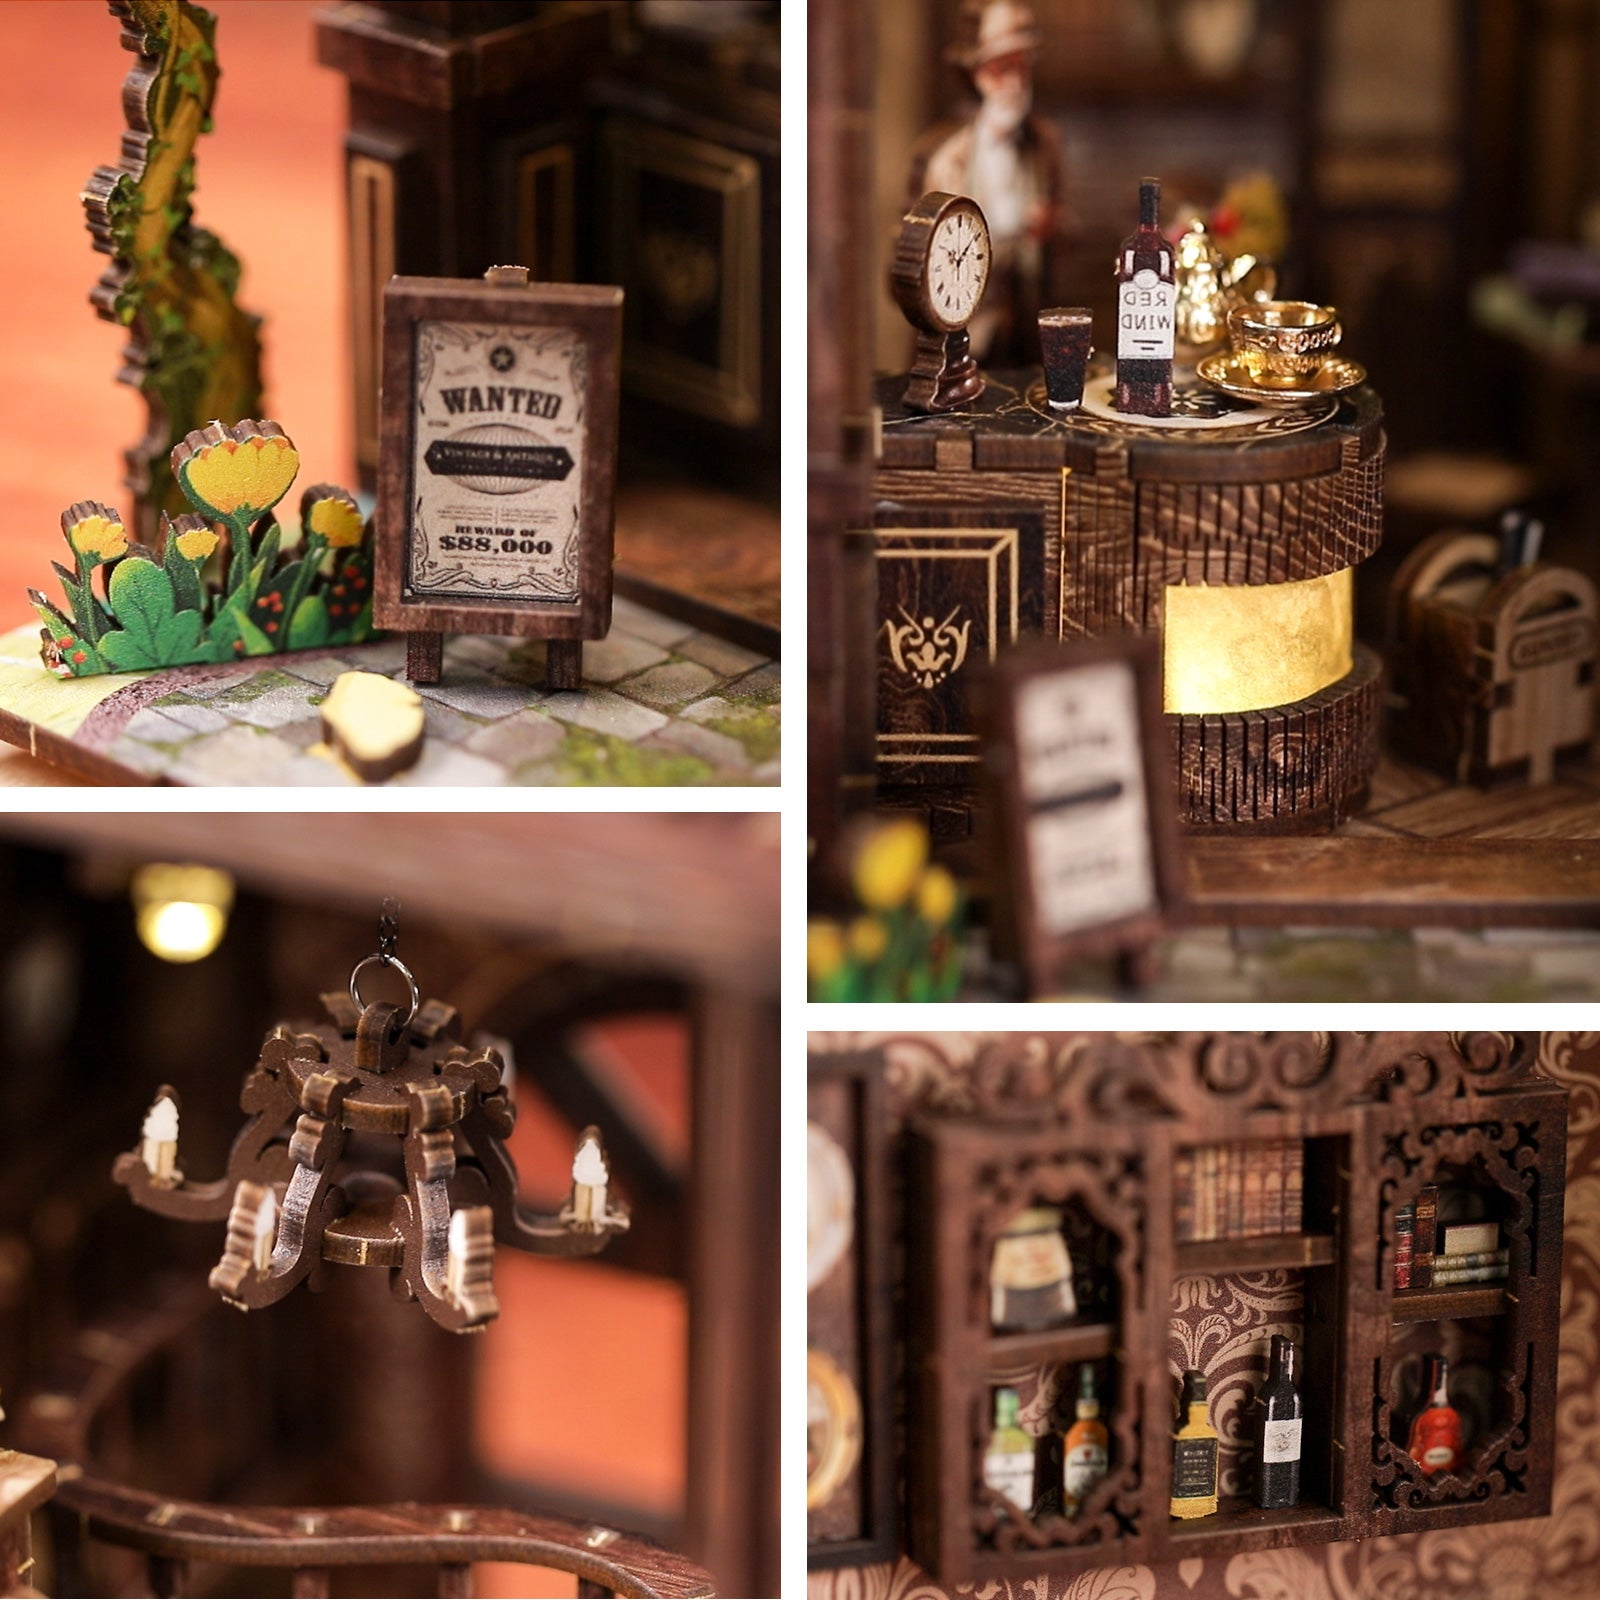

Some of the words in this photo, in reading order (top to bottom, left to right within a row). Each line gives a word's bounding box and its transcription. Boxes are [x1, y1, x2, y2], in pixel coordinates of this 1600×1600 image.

[439, 385, 562, 420] WANTED
[455, 525, 515, 537] REWARD
[519, 528, 537, 538] OF
[439, 535, 553, 555] $88,000
